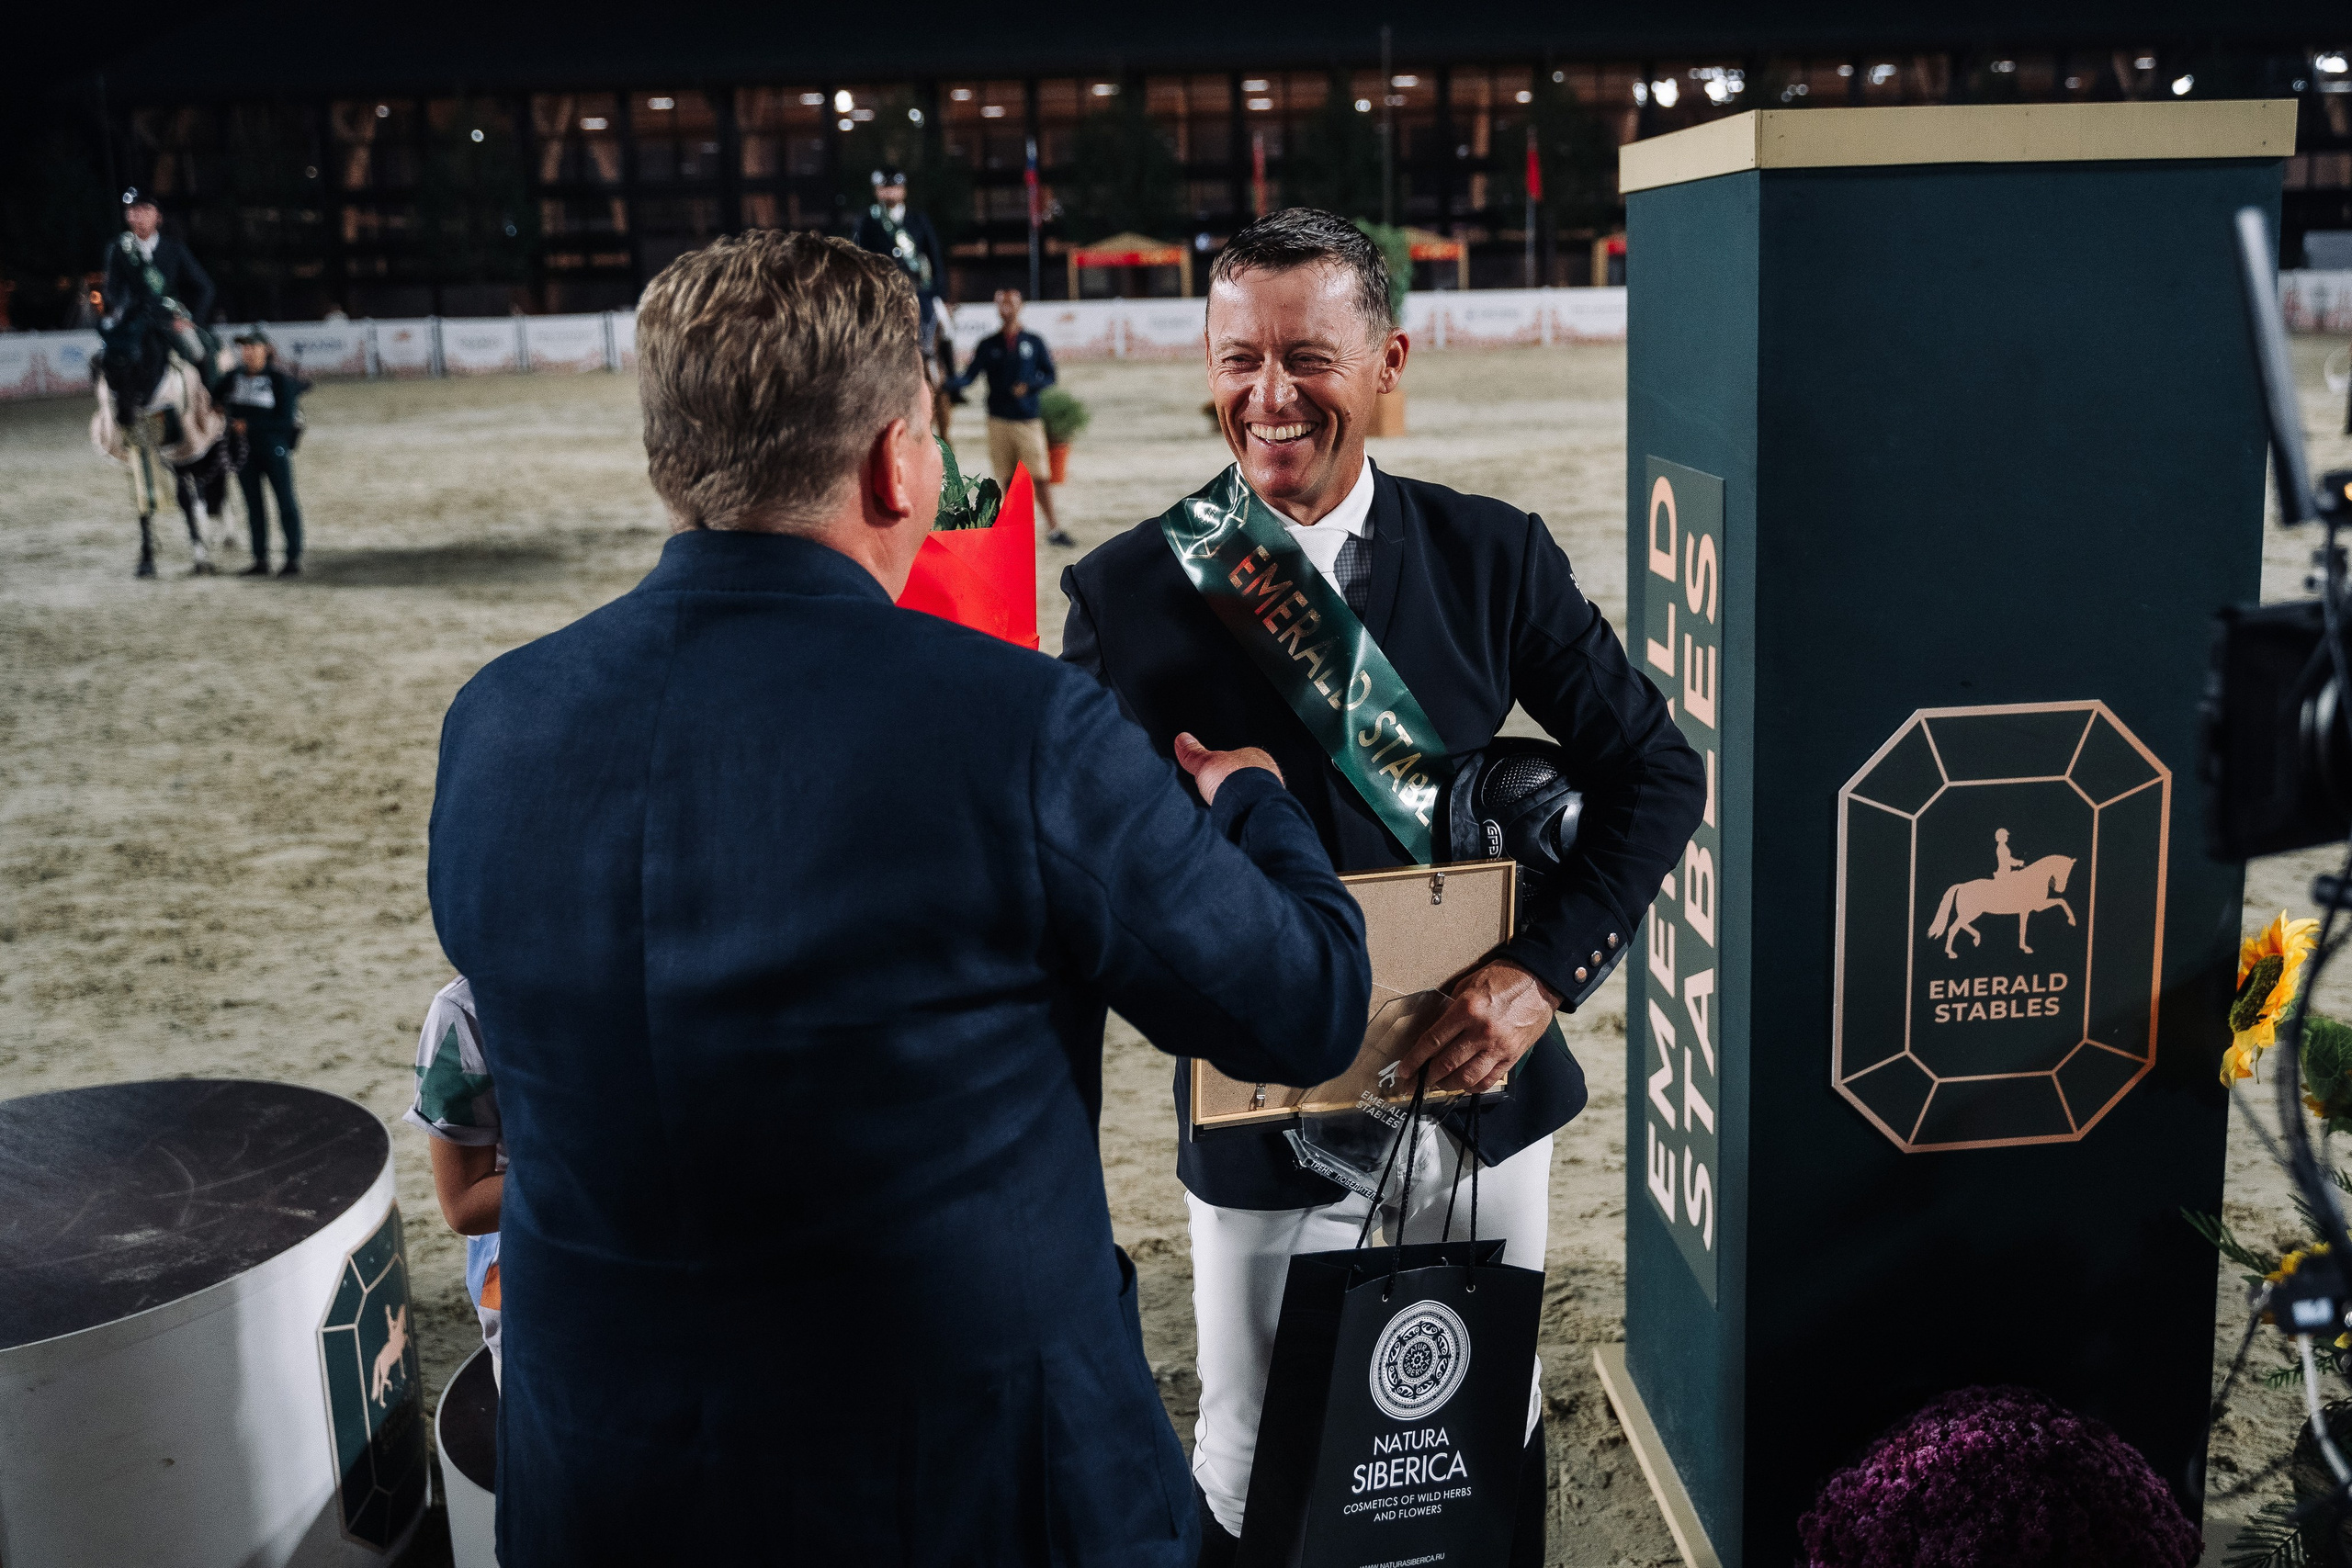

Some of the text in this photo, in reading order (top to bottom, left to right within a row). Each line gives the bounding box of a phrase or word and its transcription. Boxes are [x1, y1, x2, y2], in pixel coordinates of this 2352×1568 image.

[1228, 545, 1439, 834] EMERALD STABL
[1646, 476, 1677, 1224] EMELD
[1929, 973, 2068, 999] EMERALD
[1934, 997, 2061, 1023] STABLES
[1355, 1100, 1400, 1129] STABLES
[1334, 1173, 1378, 1201] ПОБЕДИТЕЛ
[1374, 1427, 1450, 1456] NATURA
[1351, 1450, 1468, 1494] SIBERICA
[1343, 1487, 1472, 1515] COSMETICS OF WILD HERBS
[1374, 1504, 1442, 1522] AND FLOWERS
